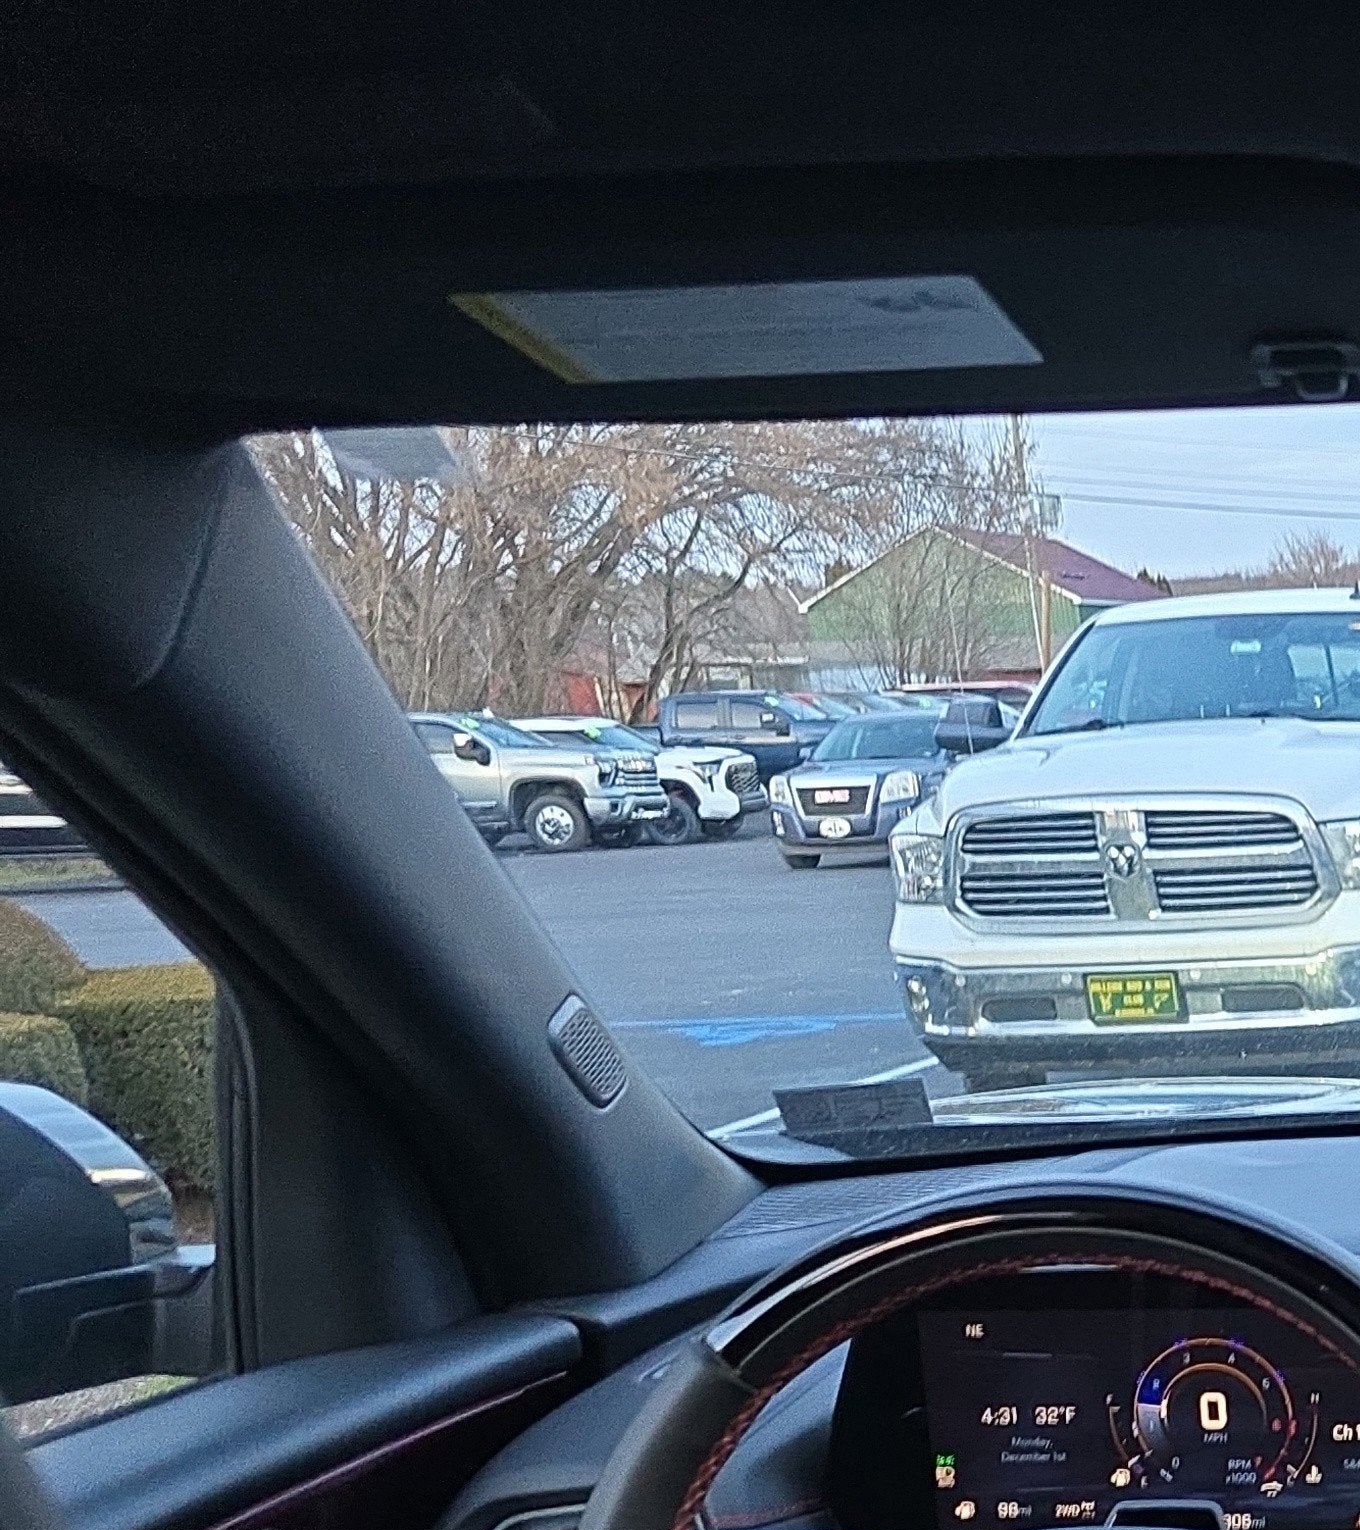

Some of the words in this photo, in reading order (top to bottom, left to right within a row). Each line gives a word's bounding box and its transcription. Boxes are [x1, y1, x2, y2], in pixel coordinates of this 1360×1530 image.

[981, 1406, 1018, 1425] 4:31
[1200, 1391, 1228, 1430] 0
[1332, 1423, 1353, 1441] Ch
